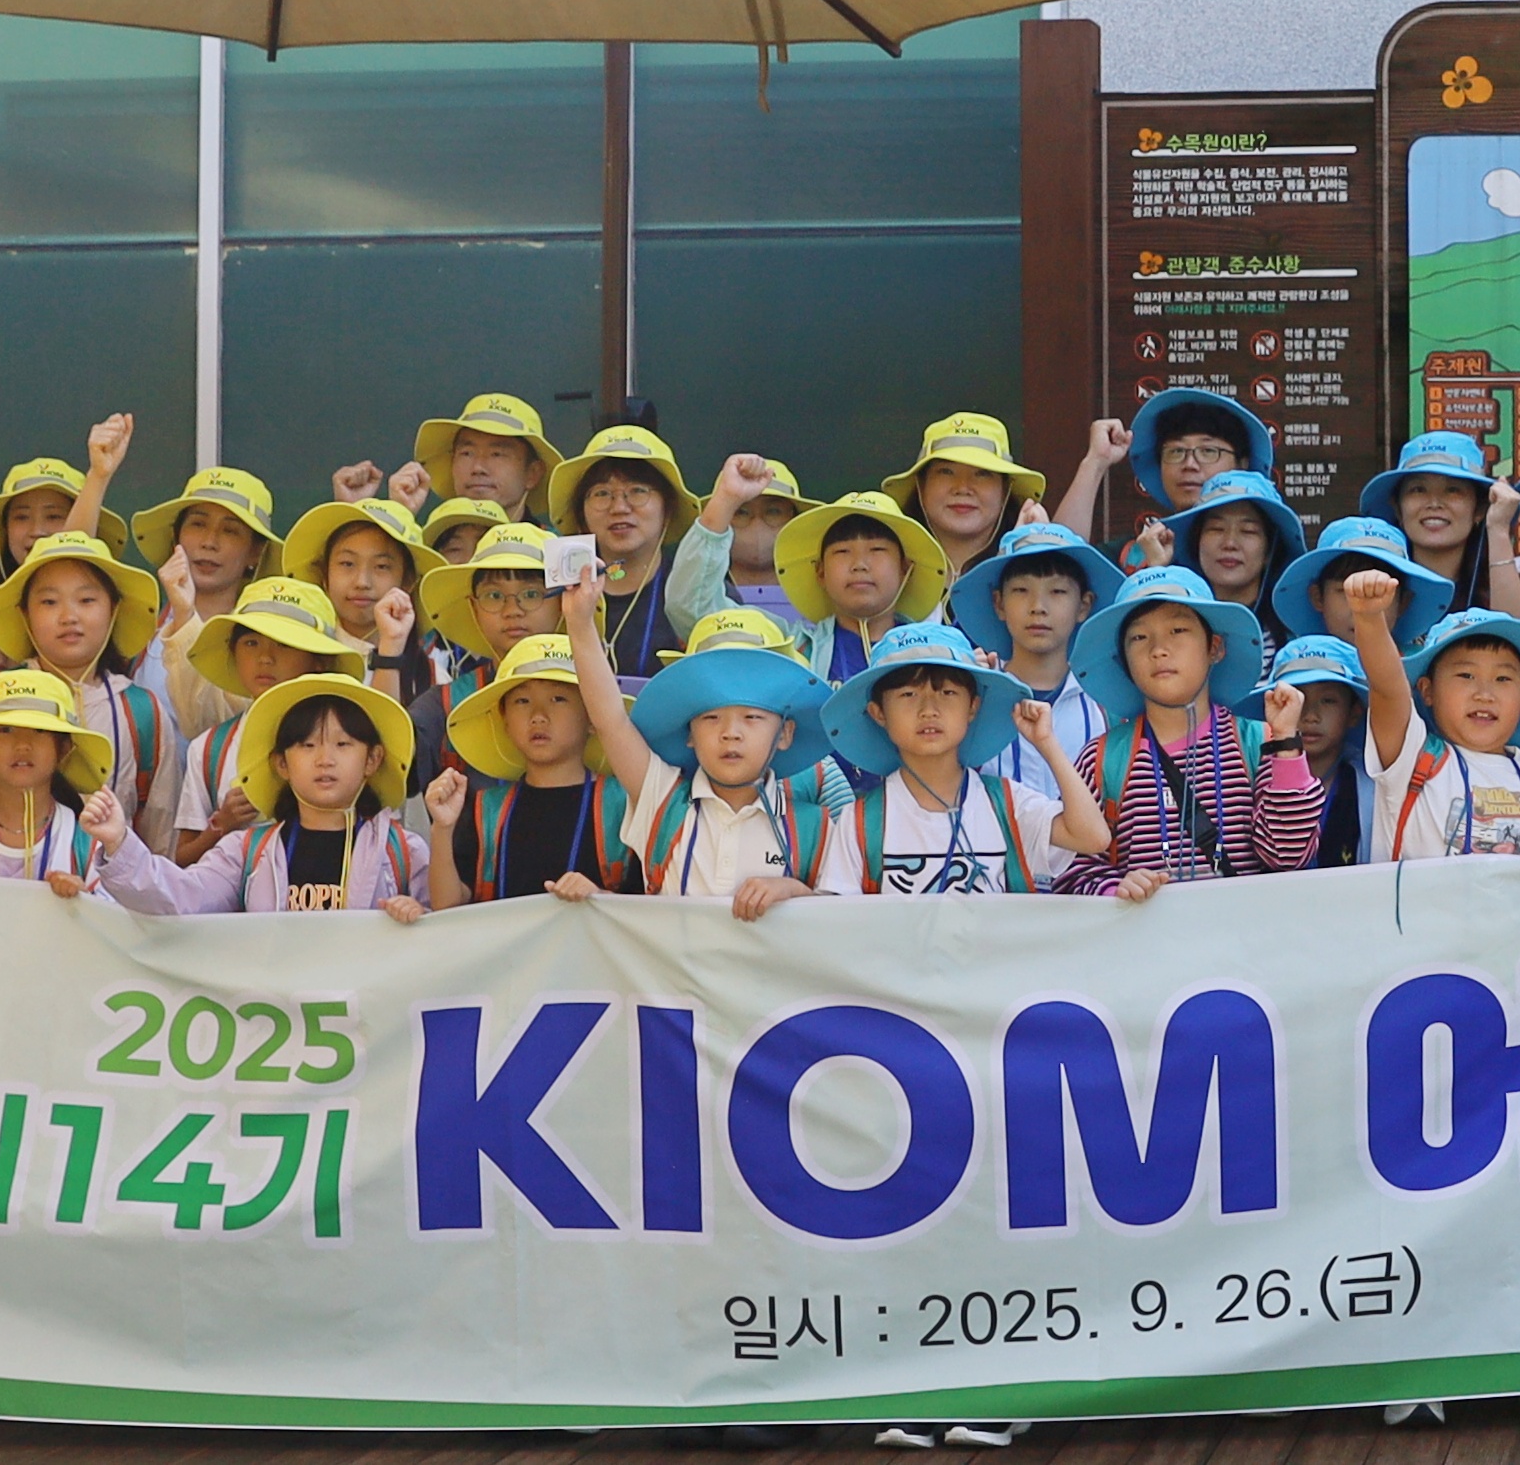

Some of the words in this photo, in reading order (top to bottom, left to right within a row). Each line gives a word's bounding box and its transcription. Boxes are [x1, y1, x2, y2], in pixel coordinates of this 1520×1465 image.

[1166, 134, 1268, 152] 수목원이란?
[1167, 257, 1220, 274] 관람객
[1228, 255, 1301, 274] 준수사항
[1431, 357, 1481, 375] 주제원
[489, 404, 511, 415] KIOM
[954, 428, 979, 436] KIOM
[209, 480, 235, 488] KIOM
[496, 535, 523, 544] KIOM
[1138, 572, 1167, 585] KIOM
[272, 594, 300, 605] KIOM
[717, 622, 744, 630] KIOM
[898, 636, 929, 648] KIOM
[6, 686, 36, 696] KIOM
[765, 851, 786, 866] Lee
[97, 989, 355, 1085] 2025
[416, 989, 1278, 1240] KIOM
[723, 1294, 845, 1362] 일시
[918, 1287, 1100, 1348] 2025.
[1131, 1277, 1187, 1334] 9.
[1214, 1245, 1423, 1326] 26.(금)
